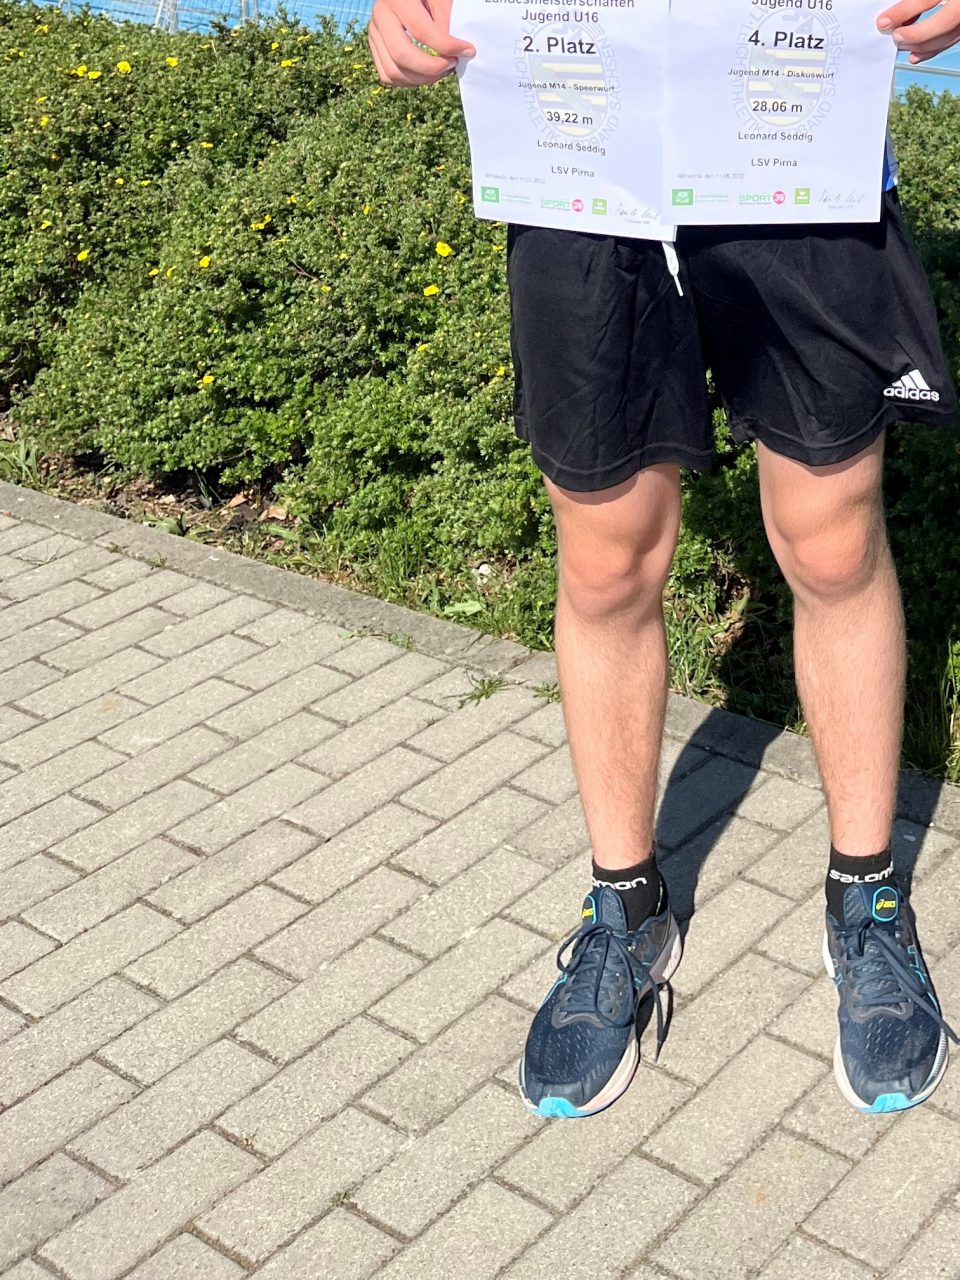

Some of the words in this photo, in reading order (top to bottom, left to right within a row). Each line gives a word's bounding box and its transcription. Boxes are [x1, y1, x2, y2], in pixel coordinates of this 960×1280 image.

[521, 10, 570, 23] Jugend
[574, 11, 599, 23] U16
[523, 36, 540, 53] 2.
[547, 37, 597, 55] Platz
[748, 30, 765, 47] 4.
[774, 31, 825, 50] Platz
[728, 68, 760, 78] Jugend
[762, 69, 780, 77] M14
[787, 70, 835, 79] Diskuswurf
[518, 81, 547, 91] Jugend
[549, 82, 566, 91] M14
[752, 101, 787, 114] 28,06
[791, 103, 803, 113] m
[546, 111, 579, 125] 39,22
[582, 115, 593, 125] m
[738, 131, 778, 141] Leonard
[780, 132, 813, 143] Seddig
[537, 139, 573, 151] Leonard
[576, 143, 606, 156] Seddig
[751, 158, 770, 167] LSV
[773, 158, 798, 167] Pirna
[551, 166, 569, 175] LSV
[572, 167, 595, 178] Pirna
[739, 194, 771, 203] SPORT
[883, 386, 940, 402] adidas
